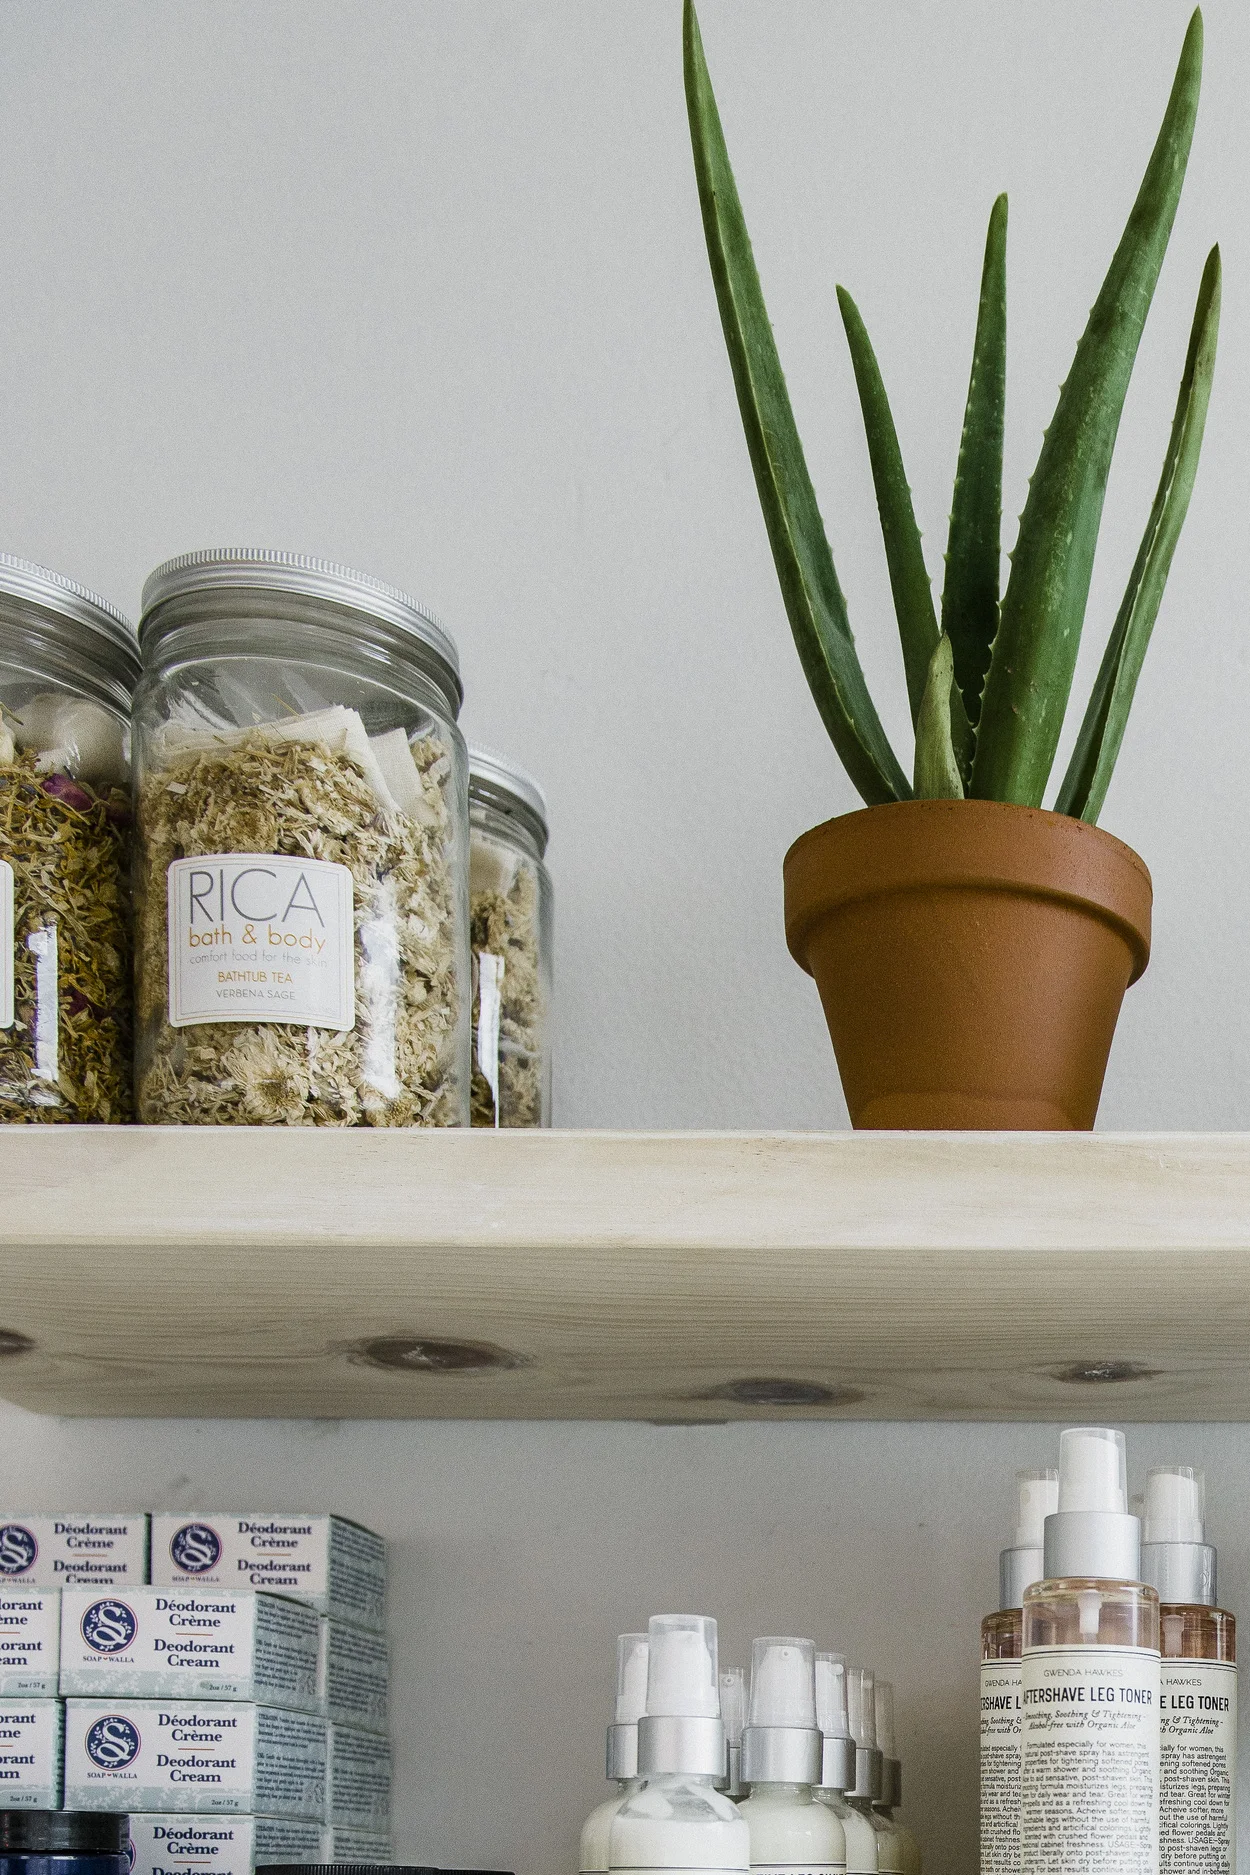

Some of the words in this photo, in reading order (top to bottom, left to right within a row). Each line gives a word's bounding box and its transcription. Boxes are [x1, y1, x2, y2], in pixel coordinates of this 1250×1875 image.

[189, 868, 325, 928] RICA
[189, 924, 233, 948] bath
[242, 924, 258, 945] &
[268, 924, 326, 954] body
[189, 951, 228, 964] comfort
[232, 950, 257, 962] food
[262, 951, 277, 962] for
[283, 952, 301, 964] the
[306, 956, 328, 968] skin
[218, 971, 267, 983] BATHTUB
[272, 971, 293, 984] TEA
[216, 989, 264, 999] VERBENA
[267, 990, 296, 1000] SAGE
[238, 1521, 313, 1535] Déodorant
[250, 1535, 299, 1548] Crème
[237, 1559, 311, 1572] Deodorant
[249, 1572, 298, 1585] Cream
[155, 1598, 236, 1613] Déodorant
[169, 1614, 221, 1627] Crème
[154, 1639, 235, 1653] Deodorant
[167, 1654, 219, 1668] Cream
[1091, 1687, 1115, 1701] LEG
[1119, 1688, 1152, 1704] TONER
[1171, 1695, 1194, 1709] LEG
[1198, 1695, 1229, 1712] TONER
[158, 1714, 237, 1727] Déodorant
[171, 1729, 222, 1742] Crème
[156, 1755, 236, 1768] Deodorant
[170, 1770, 221, 1782] Cream
[153, 1826, 234, 1840] Déodorant
[167, 1841, 219, 1854] Crème
